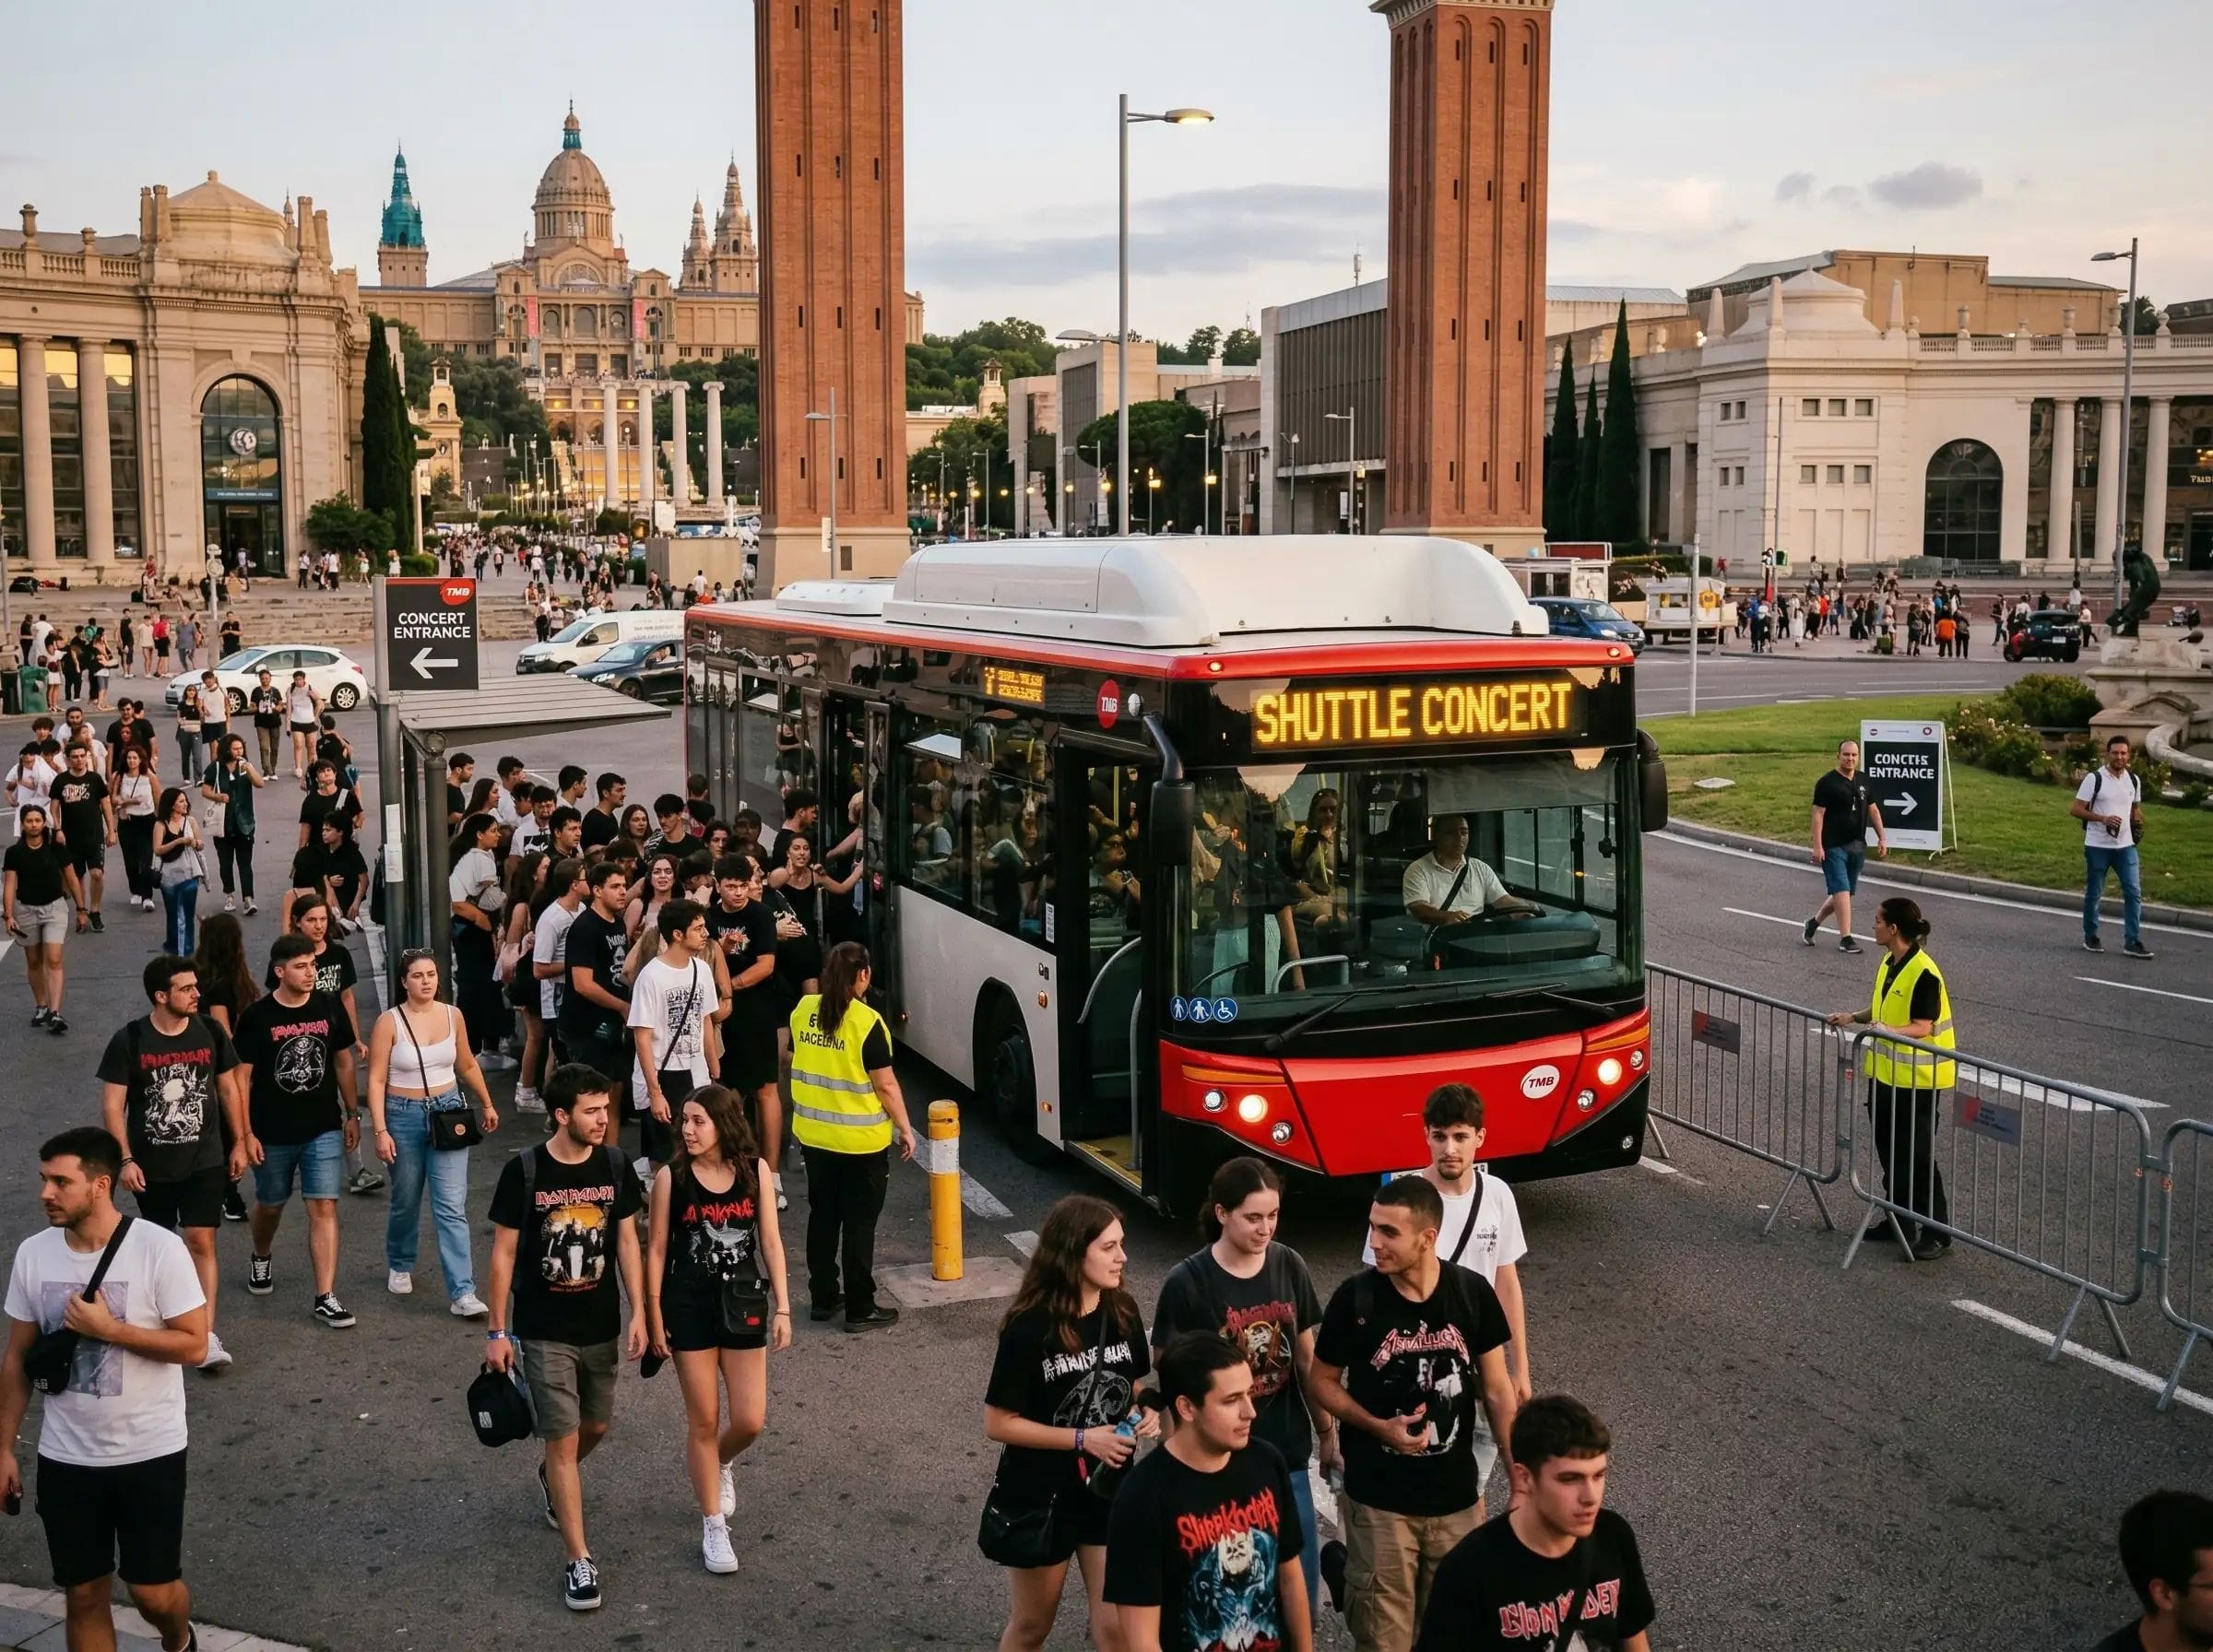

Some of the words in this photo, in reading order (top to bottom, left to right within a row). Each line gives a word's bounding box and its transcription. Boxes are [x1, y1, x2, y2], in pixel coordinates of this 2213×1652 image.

[446, 587, 470, 596] TMB
[398, 612, 466, 625] CONCERT
[394, 626, 471, 639] ENTRANCE
[1101, 697, 1118, 714] TMB
[1256, 689, 1412, 743] SHUTTLE
[1422, 682, 1572, 736] CONCERT
[1869, 767, 1935, 779] ENTRANCE
[1528, 1076, 1555, 1088] TMB
